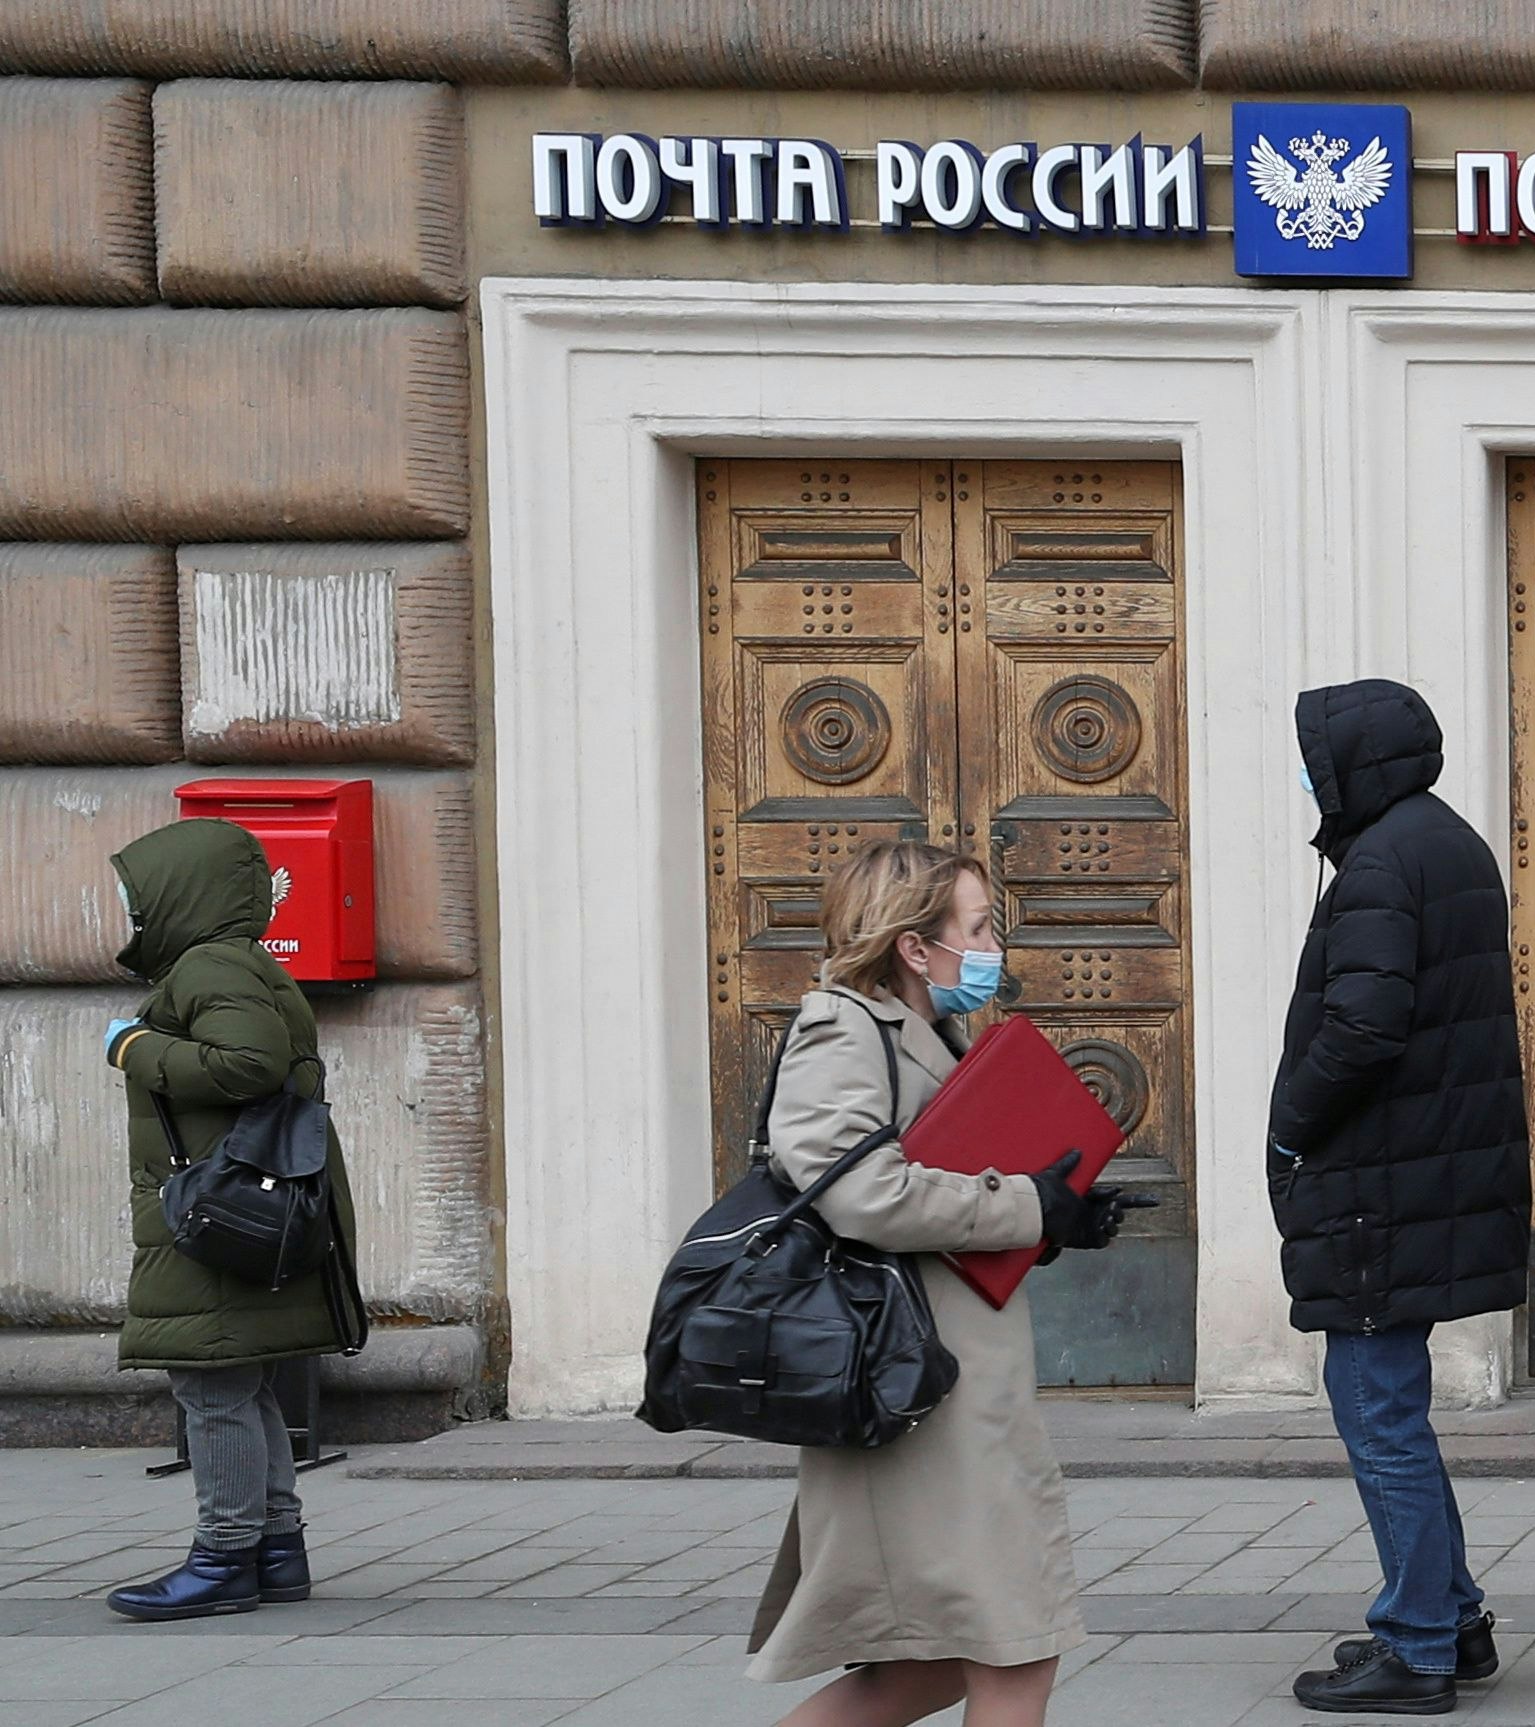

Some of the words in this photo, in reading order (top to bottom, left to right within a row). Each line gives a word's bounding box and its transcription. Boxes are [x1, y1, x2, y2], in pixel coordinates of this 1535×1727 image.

[532, 133, 844, 227] ПОЧТА
[877, 140, 1199, 233] РОССИИ
[257, 939, 299, 953] ССИИ
